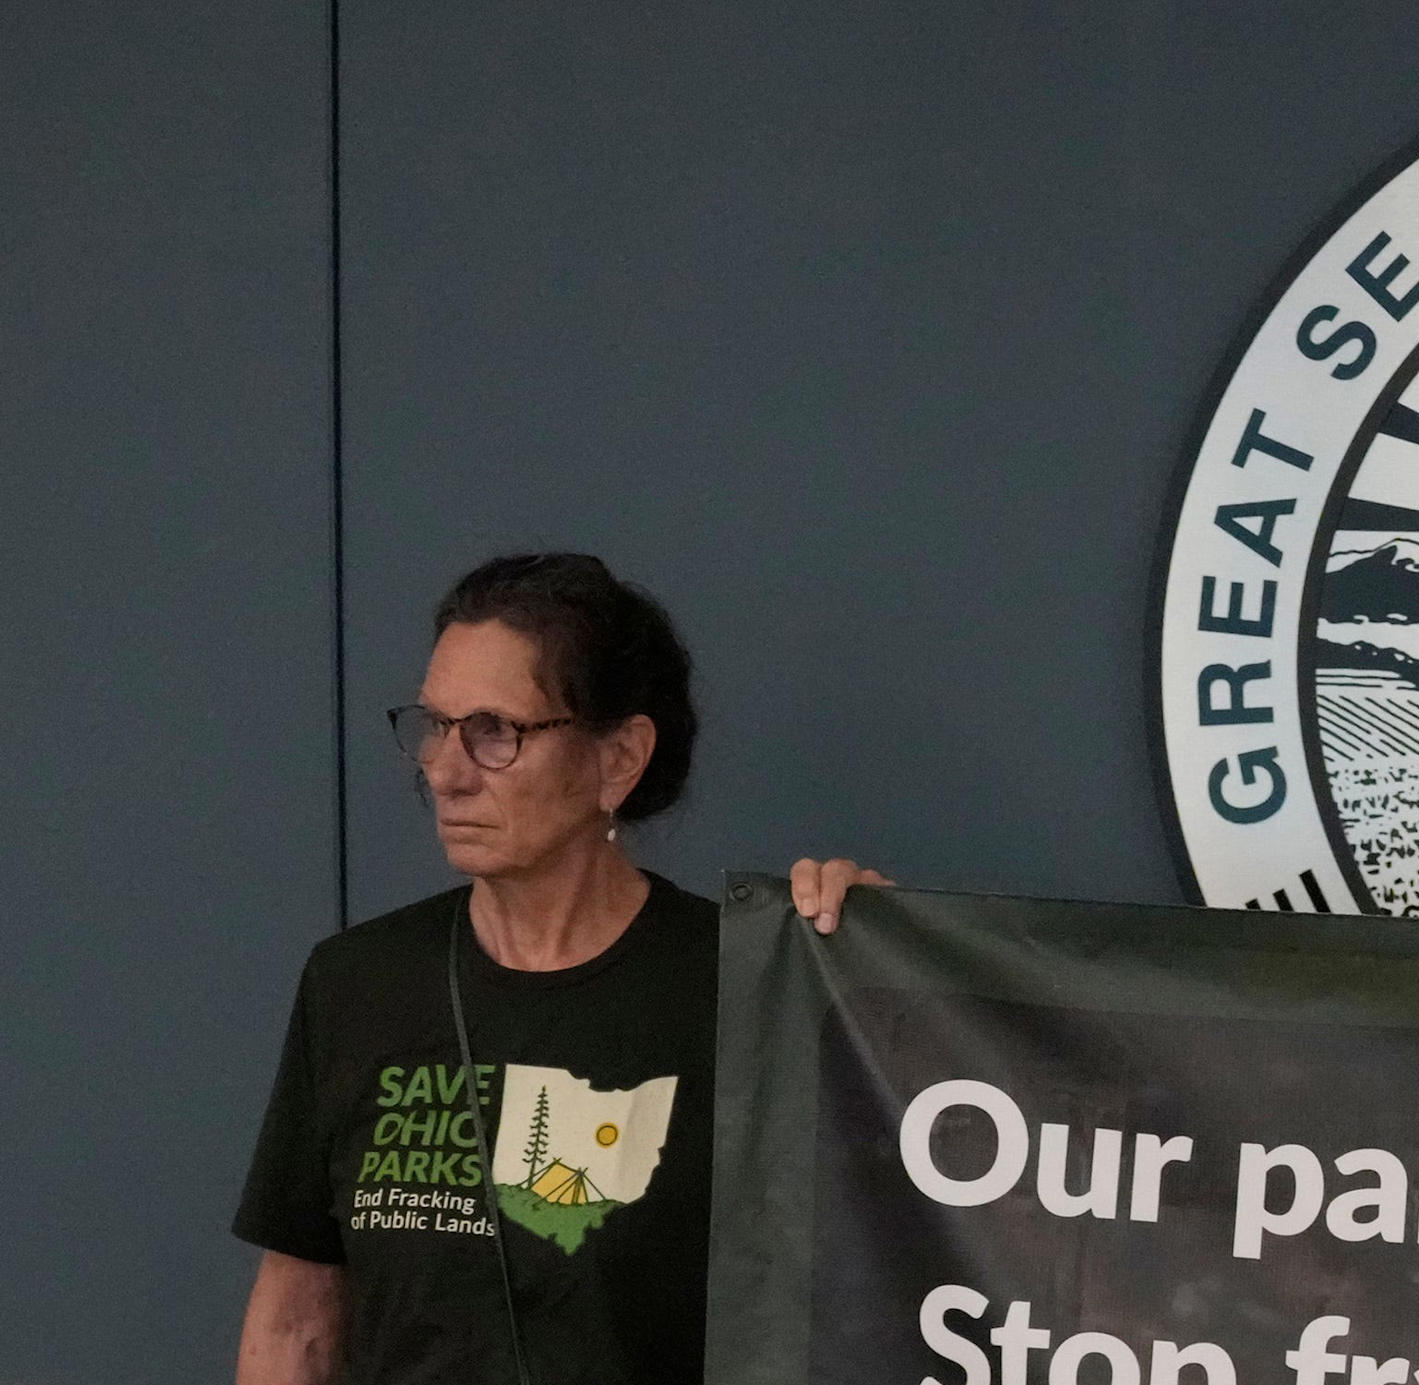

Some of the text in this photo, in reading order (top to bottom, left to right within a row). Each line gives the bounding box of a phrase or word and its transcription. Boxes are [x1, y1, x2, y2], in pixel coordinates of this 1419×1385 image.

[1197, 407, 1315, 825] GREAT
[377, 1064, 496, 1107] SAVE
[373, 1110, 479, 1148] OHIO
[357, 1150, 483, 1187] PARKS
[899, 1079, 1194, 1223] Our
[353, 1188, 475, 1216] End Fracking
[350, 1210, 496, 1238] of Public Lands
